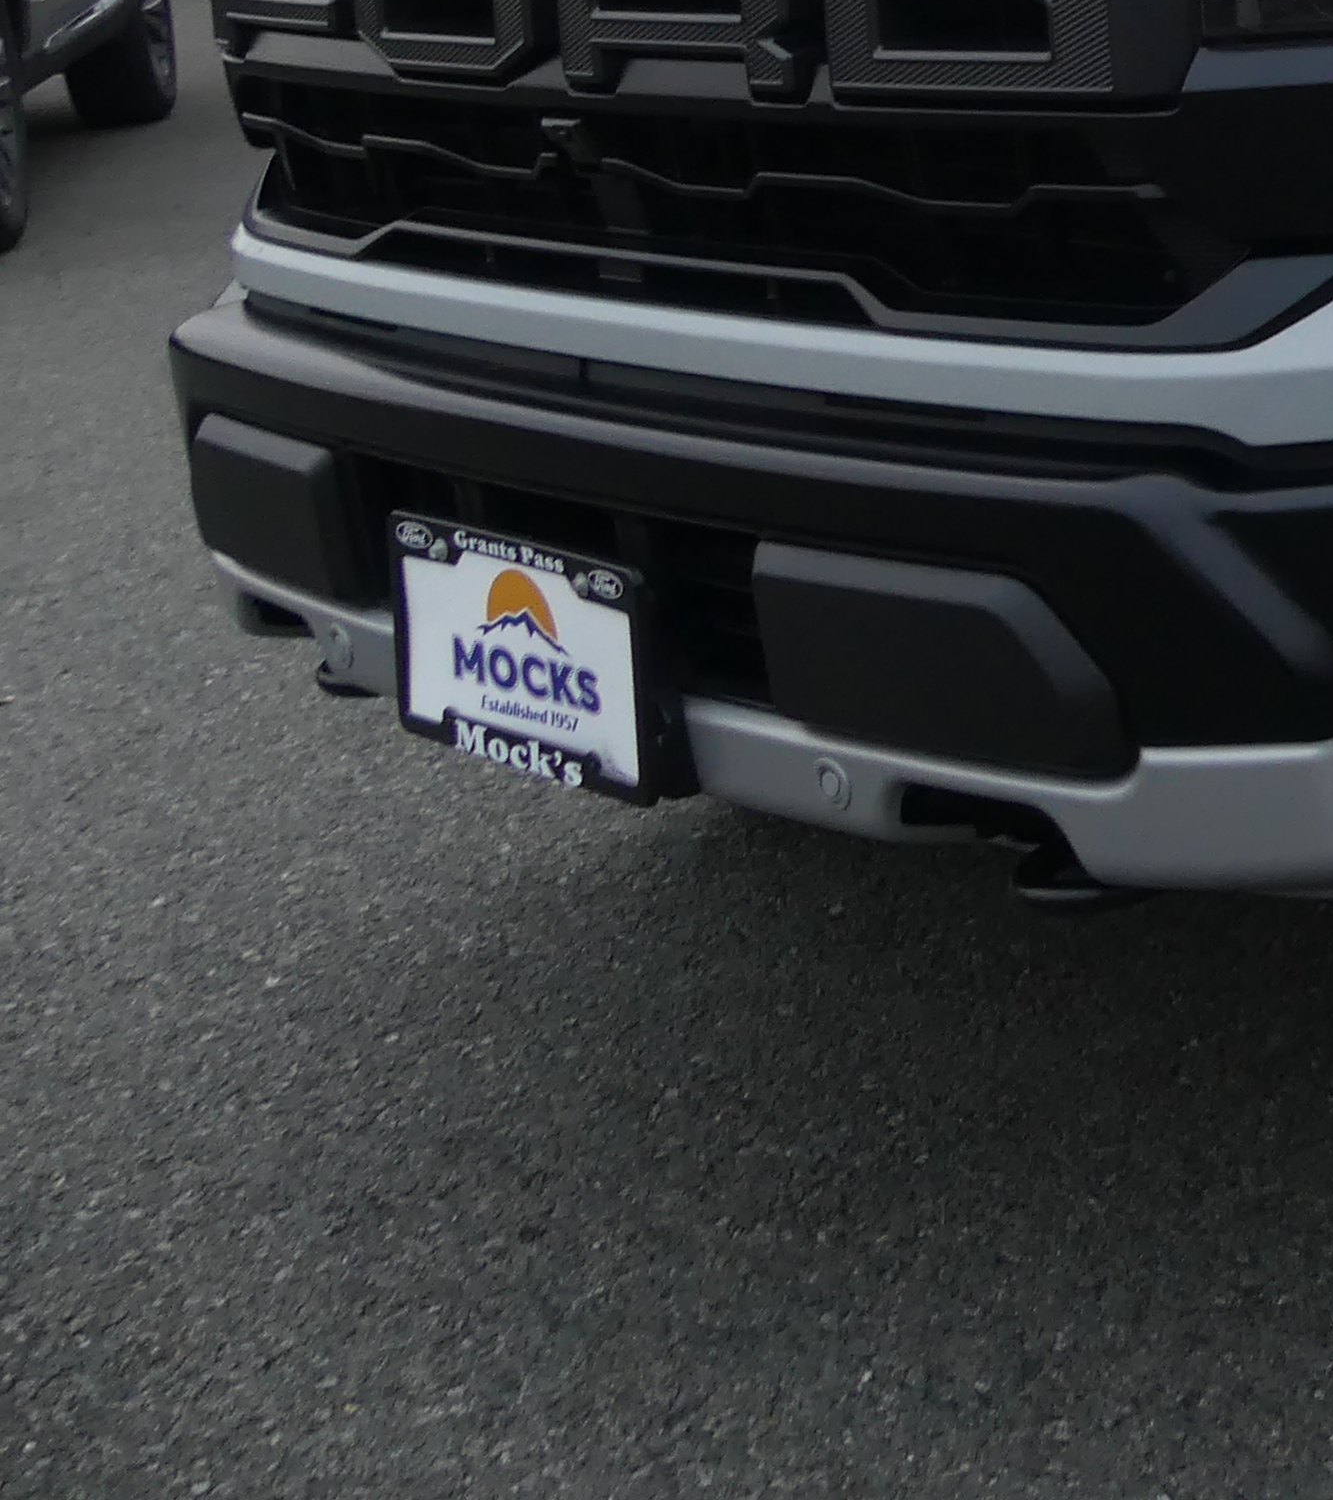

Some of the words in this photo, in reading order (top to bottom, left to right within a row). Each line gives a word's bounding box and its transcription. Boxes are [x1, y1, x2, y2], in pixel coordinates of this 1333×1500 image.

[454, 530, 517, 562] Grants
[520, 546, 565, 574] Pass
[453, 636, 601, 714] MOCKS
[481, 694, 548, 726] Established
[550, 710, 579, 732] 1957
[455, 719, 584, 789] Mock's
